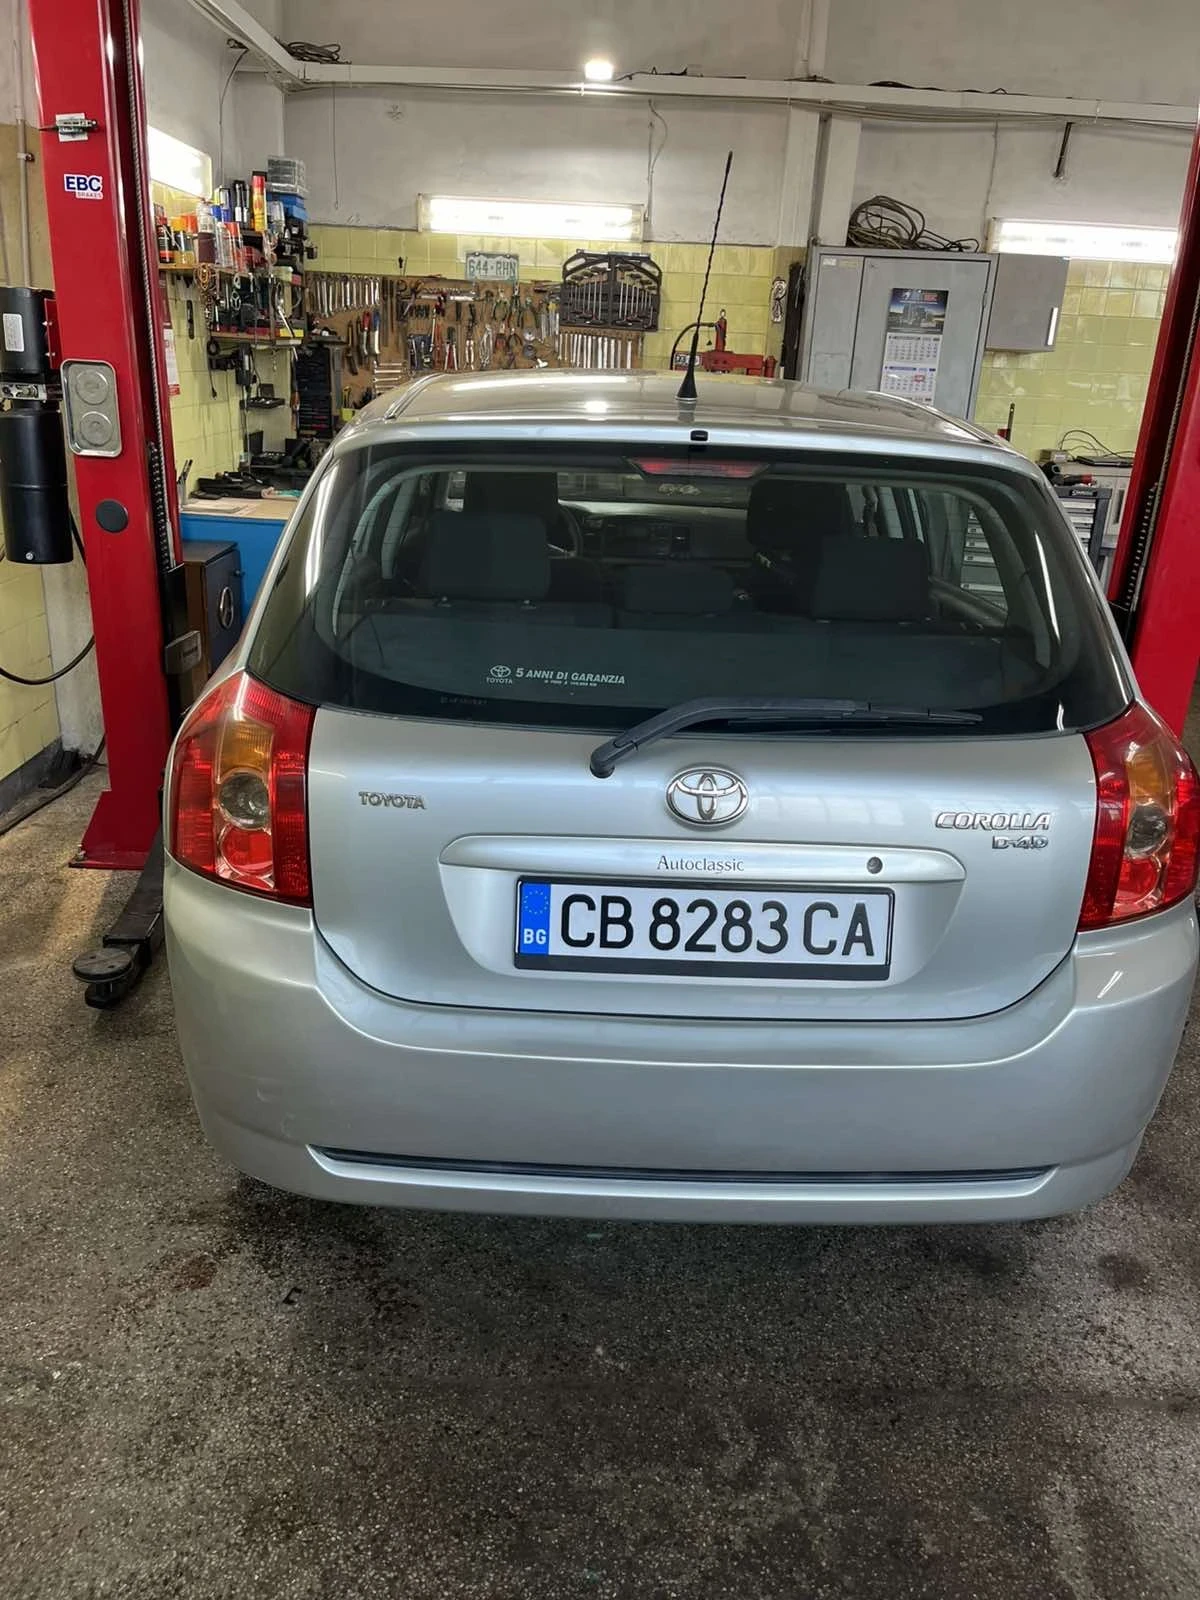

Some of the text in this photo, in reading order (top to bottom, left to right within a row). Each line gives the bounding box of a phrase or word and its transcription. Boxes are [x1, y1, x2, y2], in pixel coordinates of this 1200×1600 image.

[65, 175, 101, 192] EBC
[486, 677, 513, 685] TOYOTA
[516, 667, 525, 678] 5
[525, 669, 554, 680] ANNI
[556, 671, 569, 680] DI
[571, 672, 625, 684] GARANZIA
[358, 791, 426, 810] TOYOTA
[935, 811, 1051, 831] COROLLA
[991, 835, 1049, 850] D-4D
[657, 855, 745, 873] Autoclassic
[560, 893, 876, 957] CB 8283 CA
[523, 928, 547, 945] BG
